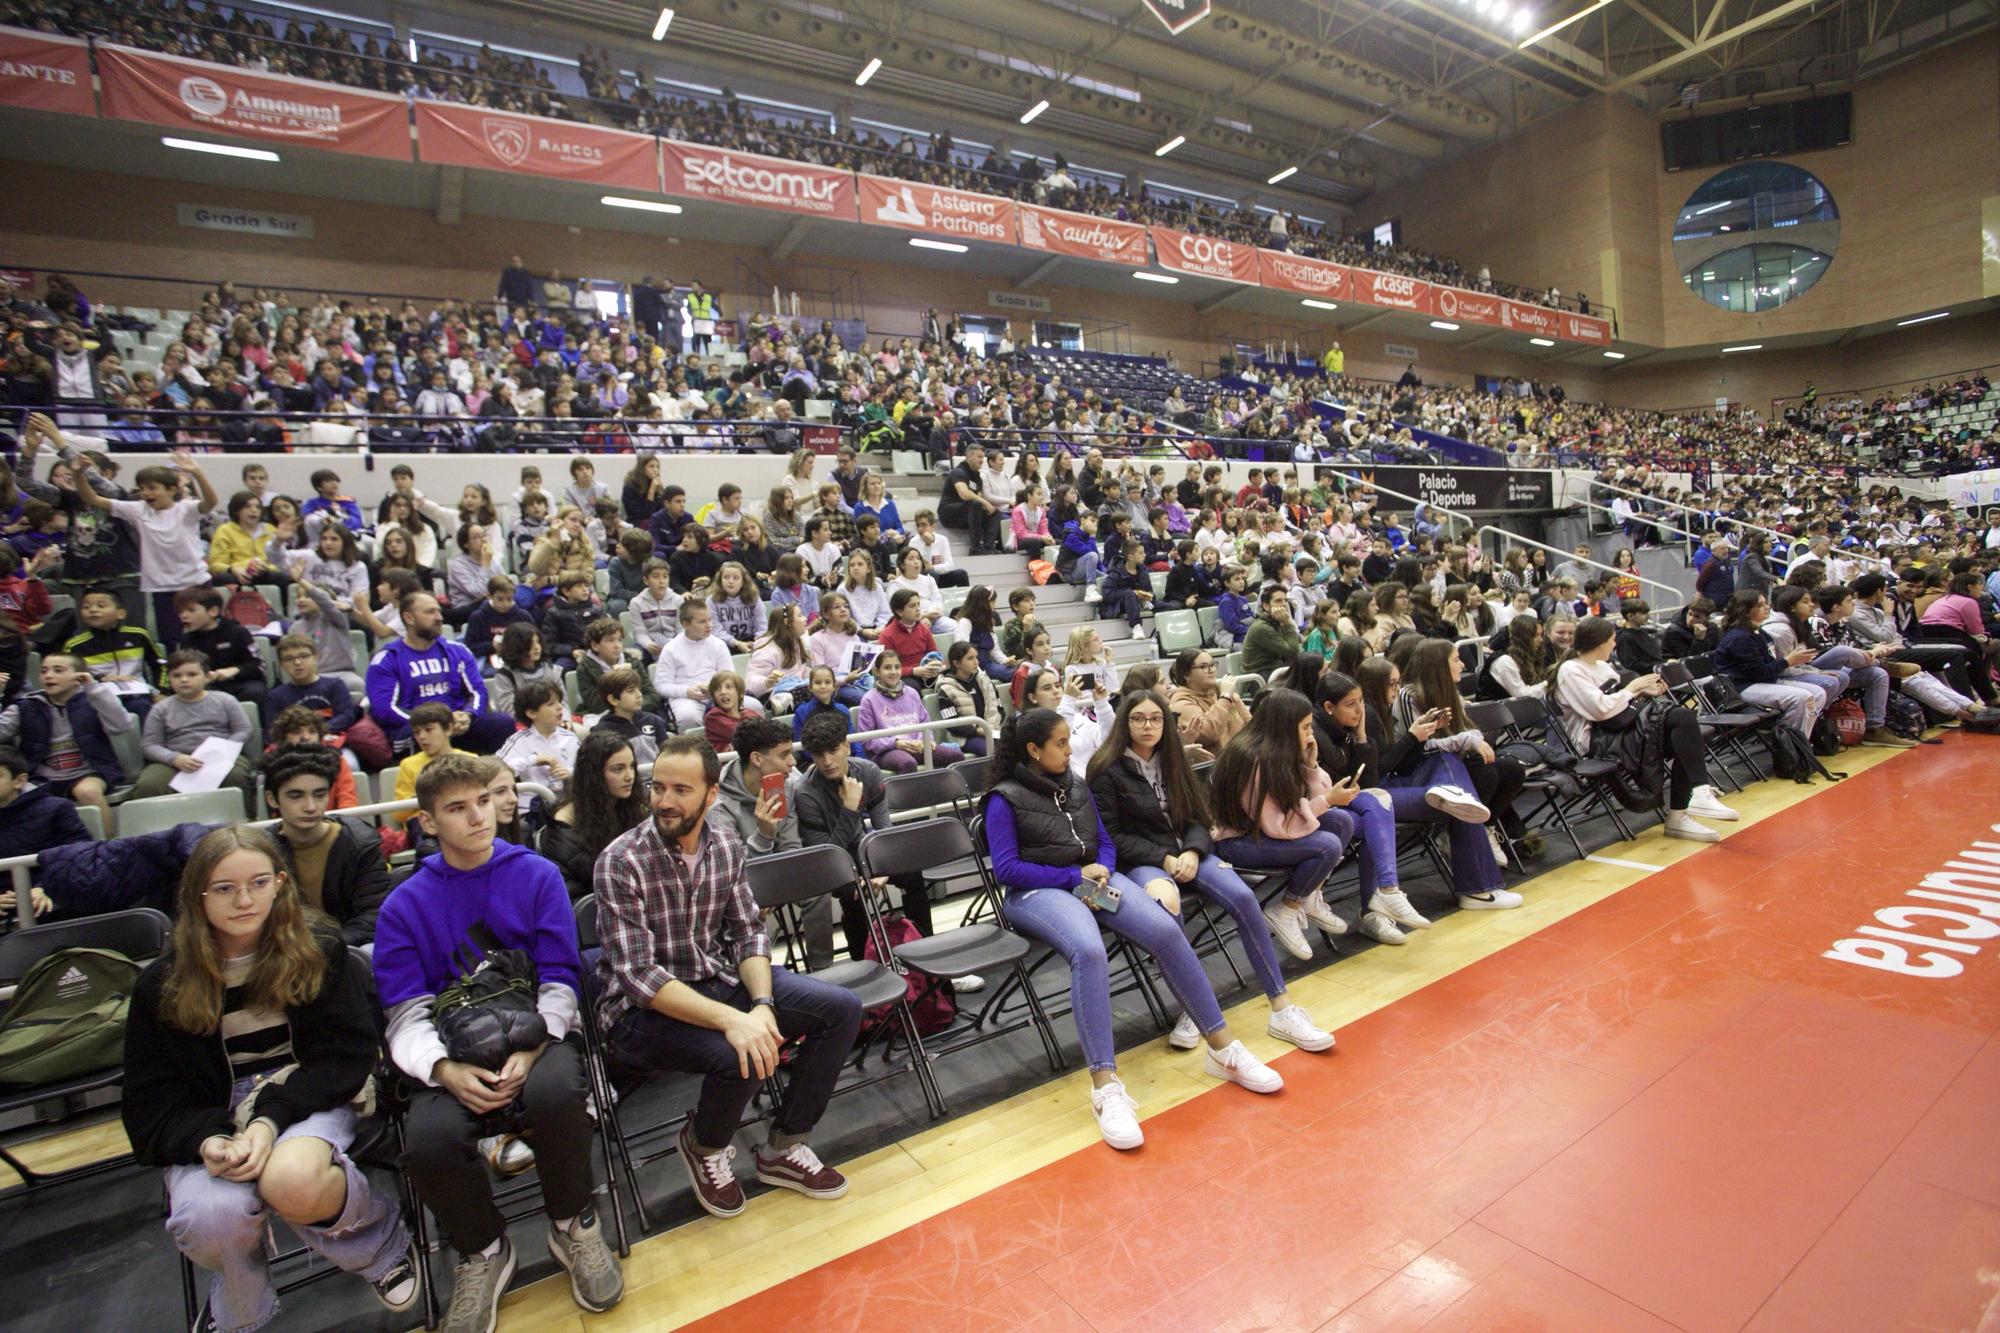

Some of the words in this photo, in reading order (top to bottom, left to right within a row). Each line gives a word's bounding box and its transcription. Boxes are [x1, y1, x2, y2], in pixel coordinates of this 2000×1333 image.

[237, 110, 283, 124] RENT
[287, 118, 299, 127] A
[684, 155, 839, 202] setcomur
[932, 191, 995, 217] Asterra
[195, 209, 260, 228] Grada
[268, 216, 297, 231] Sur
[932, 211, 1005, 238] Partners
[1418, 472, 1457, 490] Palacio
[1430, 489, 1477, 509] Deportes
[730, 623, 748, 637] 92
